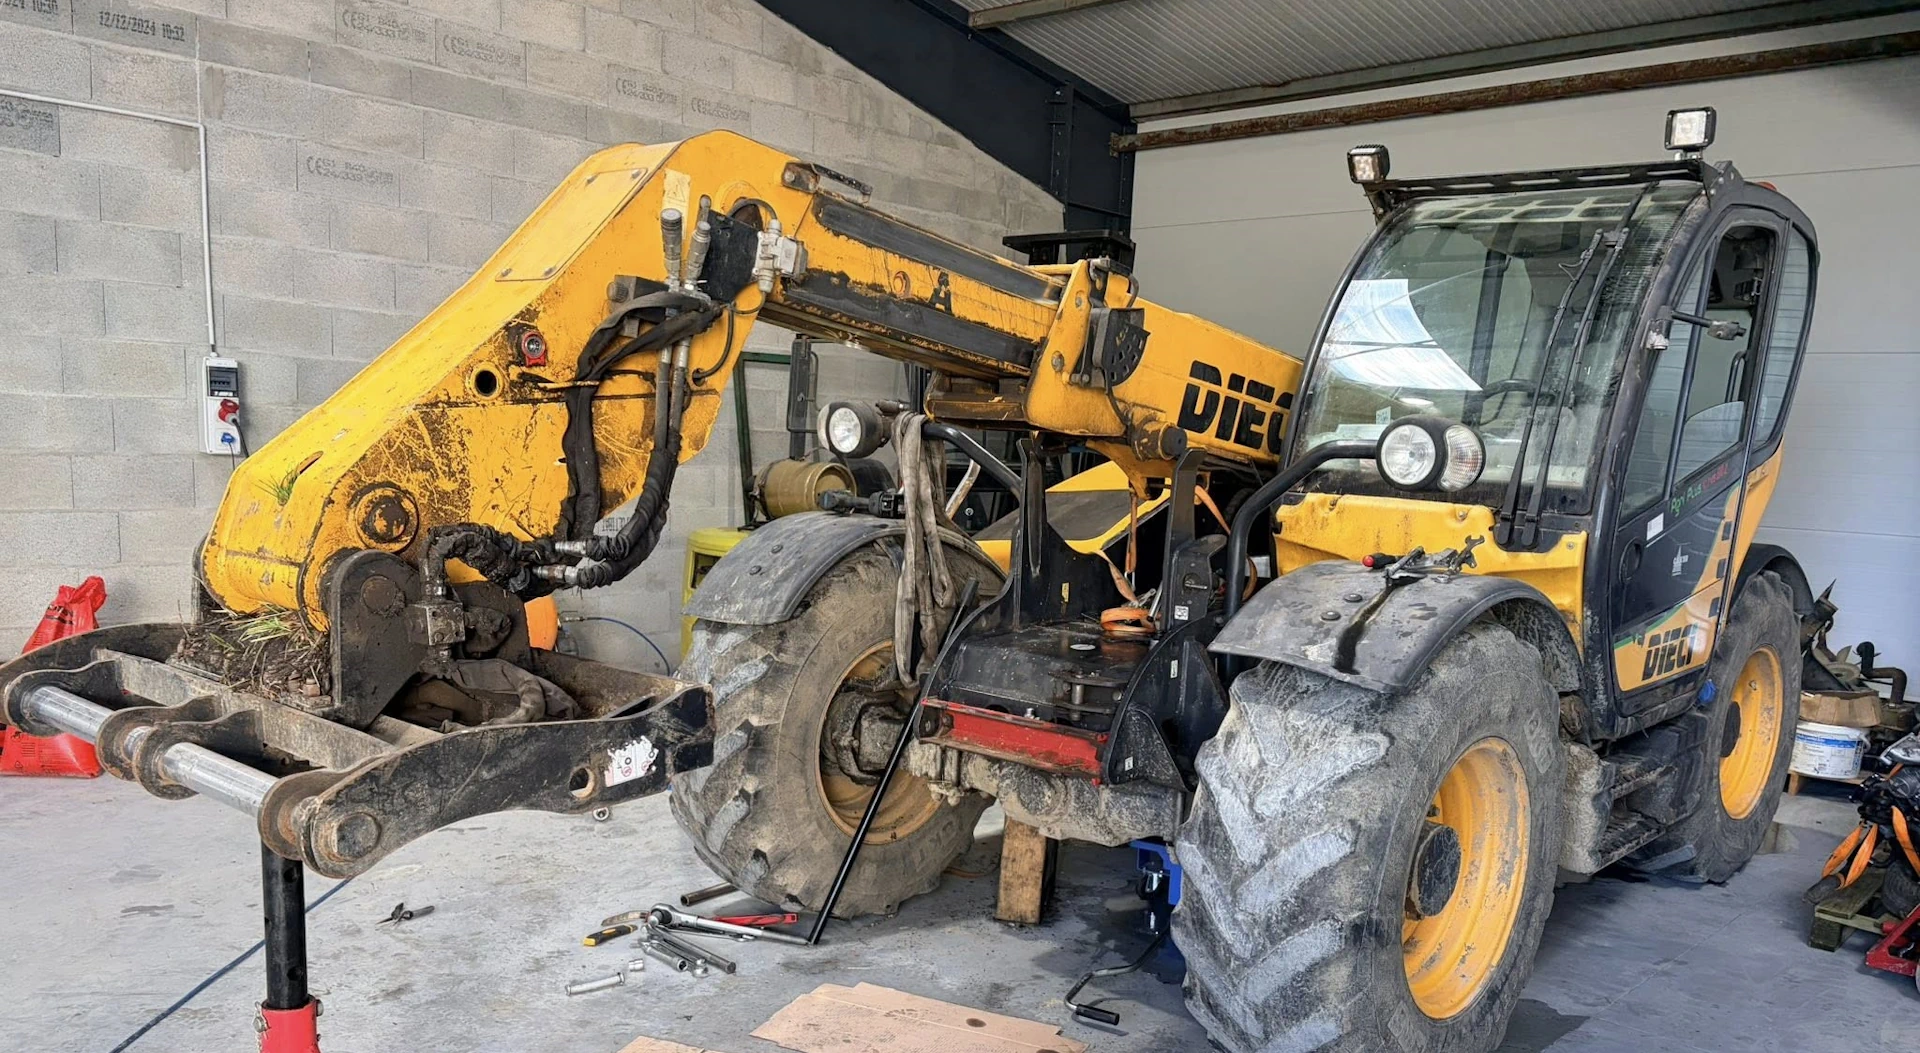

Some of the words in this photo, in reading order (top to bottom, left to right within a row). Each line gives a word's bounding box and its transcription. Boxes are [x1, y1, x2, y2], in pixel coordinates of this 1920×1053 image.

[98, 10, 157, 37] 12/12/2024
[161, 22, 186, 42] 10:32
[1642, 622, 1698, 681] DIECI
